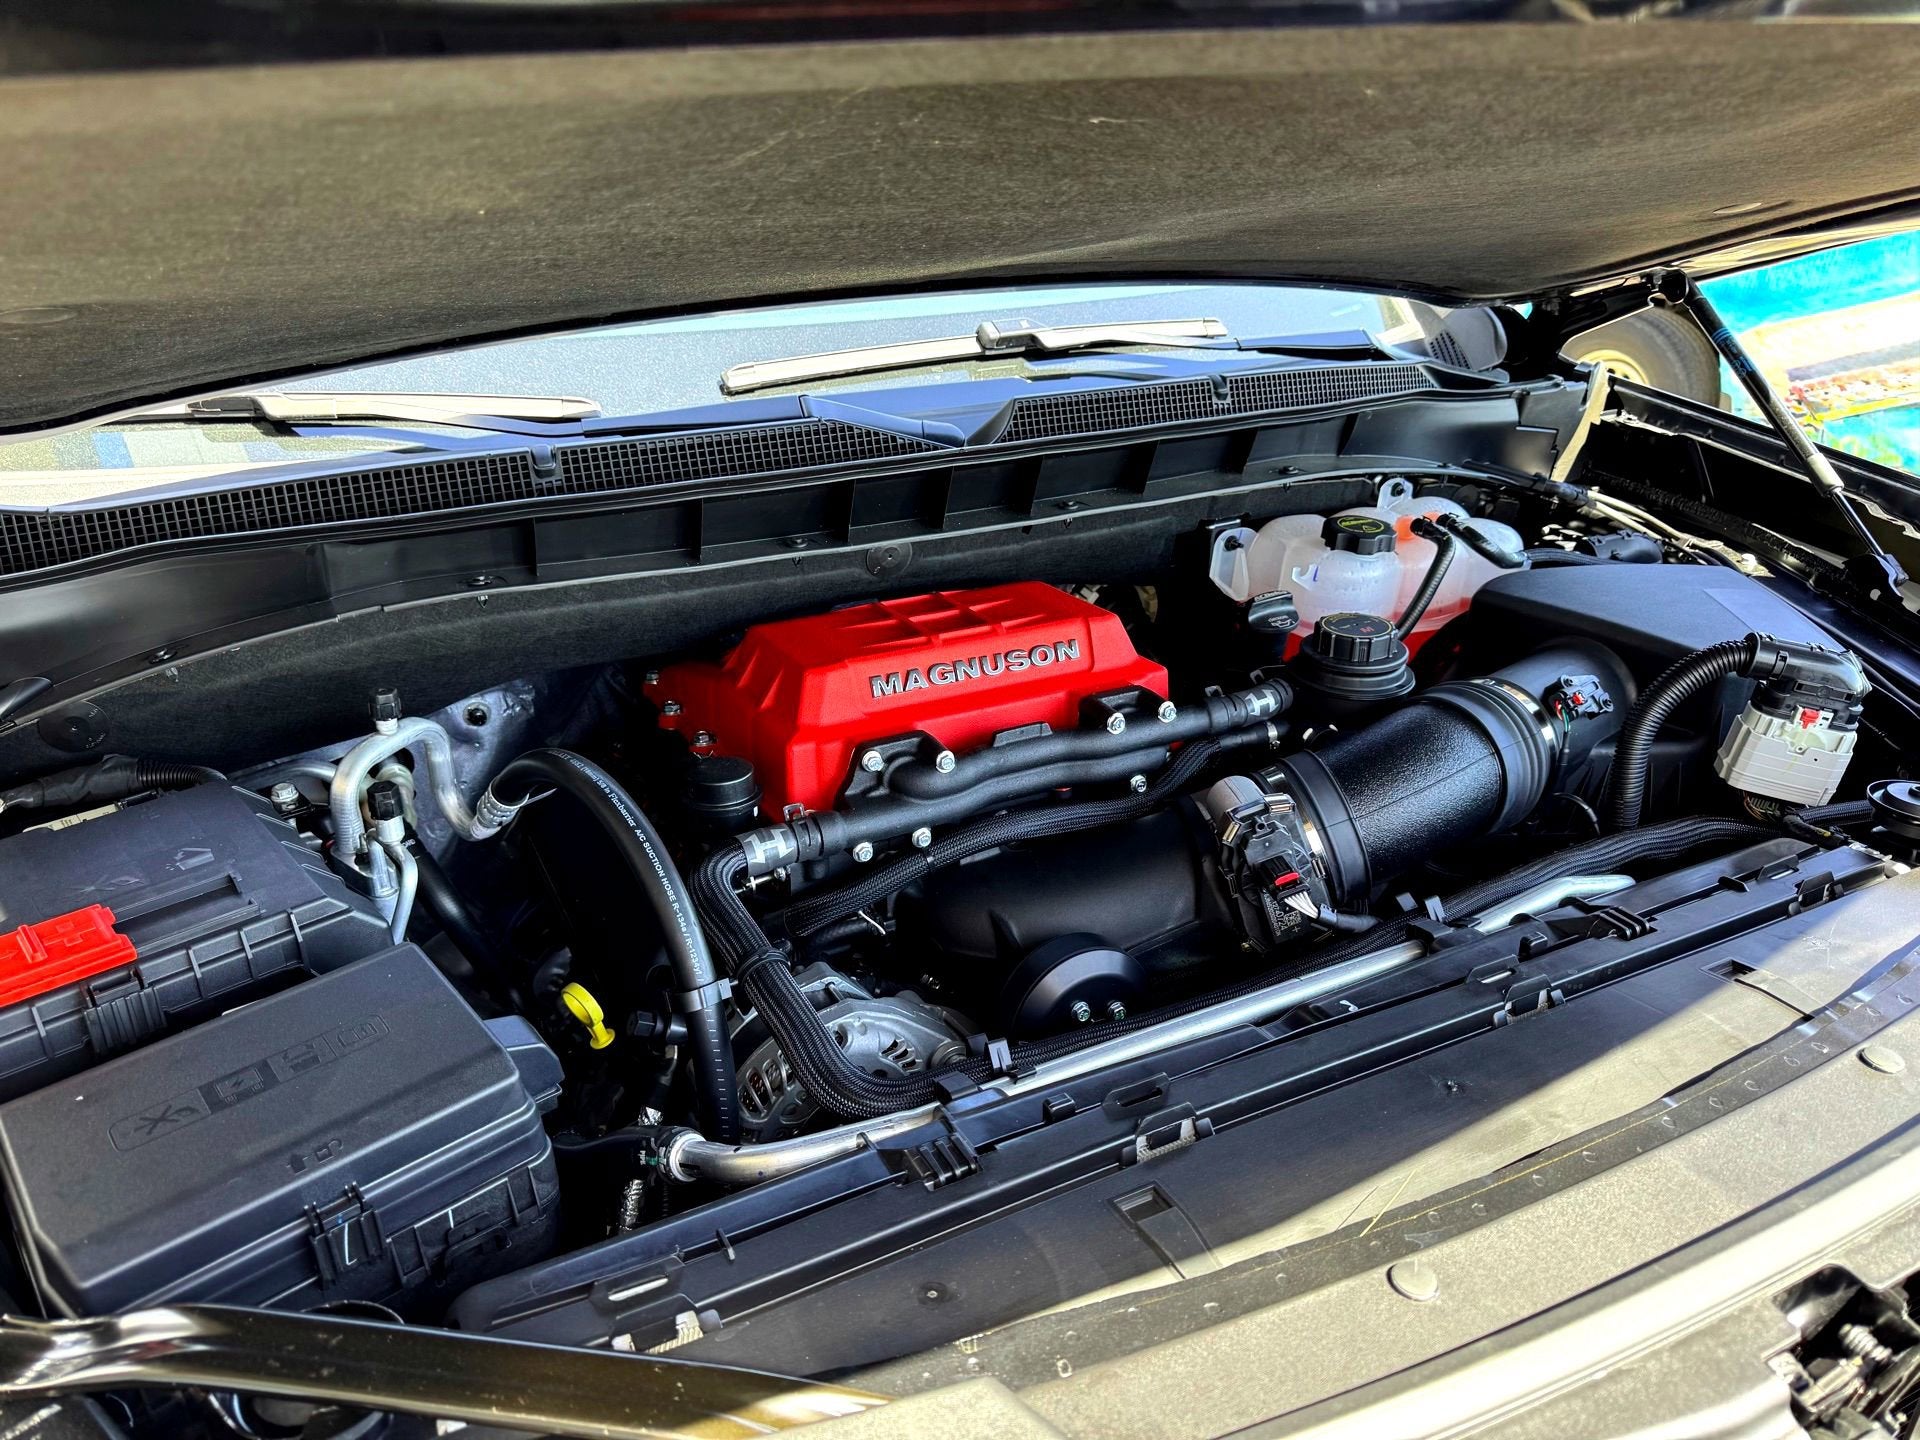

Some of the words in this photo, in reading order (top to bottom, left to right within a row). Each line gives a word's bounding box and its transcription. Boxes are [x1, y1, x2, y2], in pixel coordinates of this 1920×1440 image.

[869, 639, 1080, 698] MAGNUSON
[608, 793, 637, 828] Flexbarrier
[634, 829, 647, 842] A/C
[643, 842, 666, 877] SUCTION
[661, 878, 677, 902] HOSE
[672, 902, 687, 932] R-134a
[685, 938, 703, 975] R-1234yf
